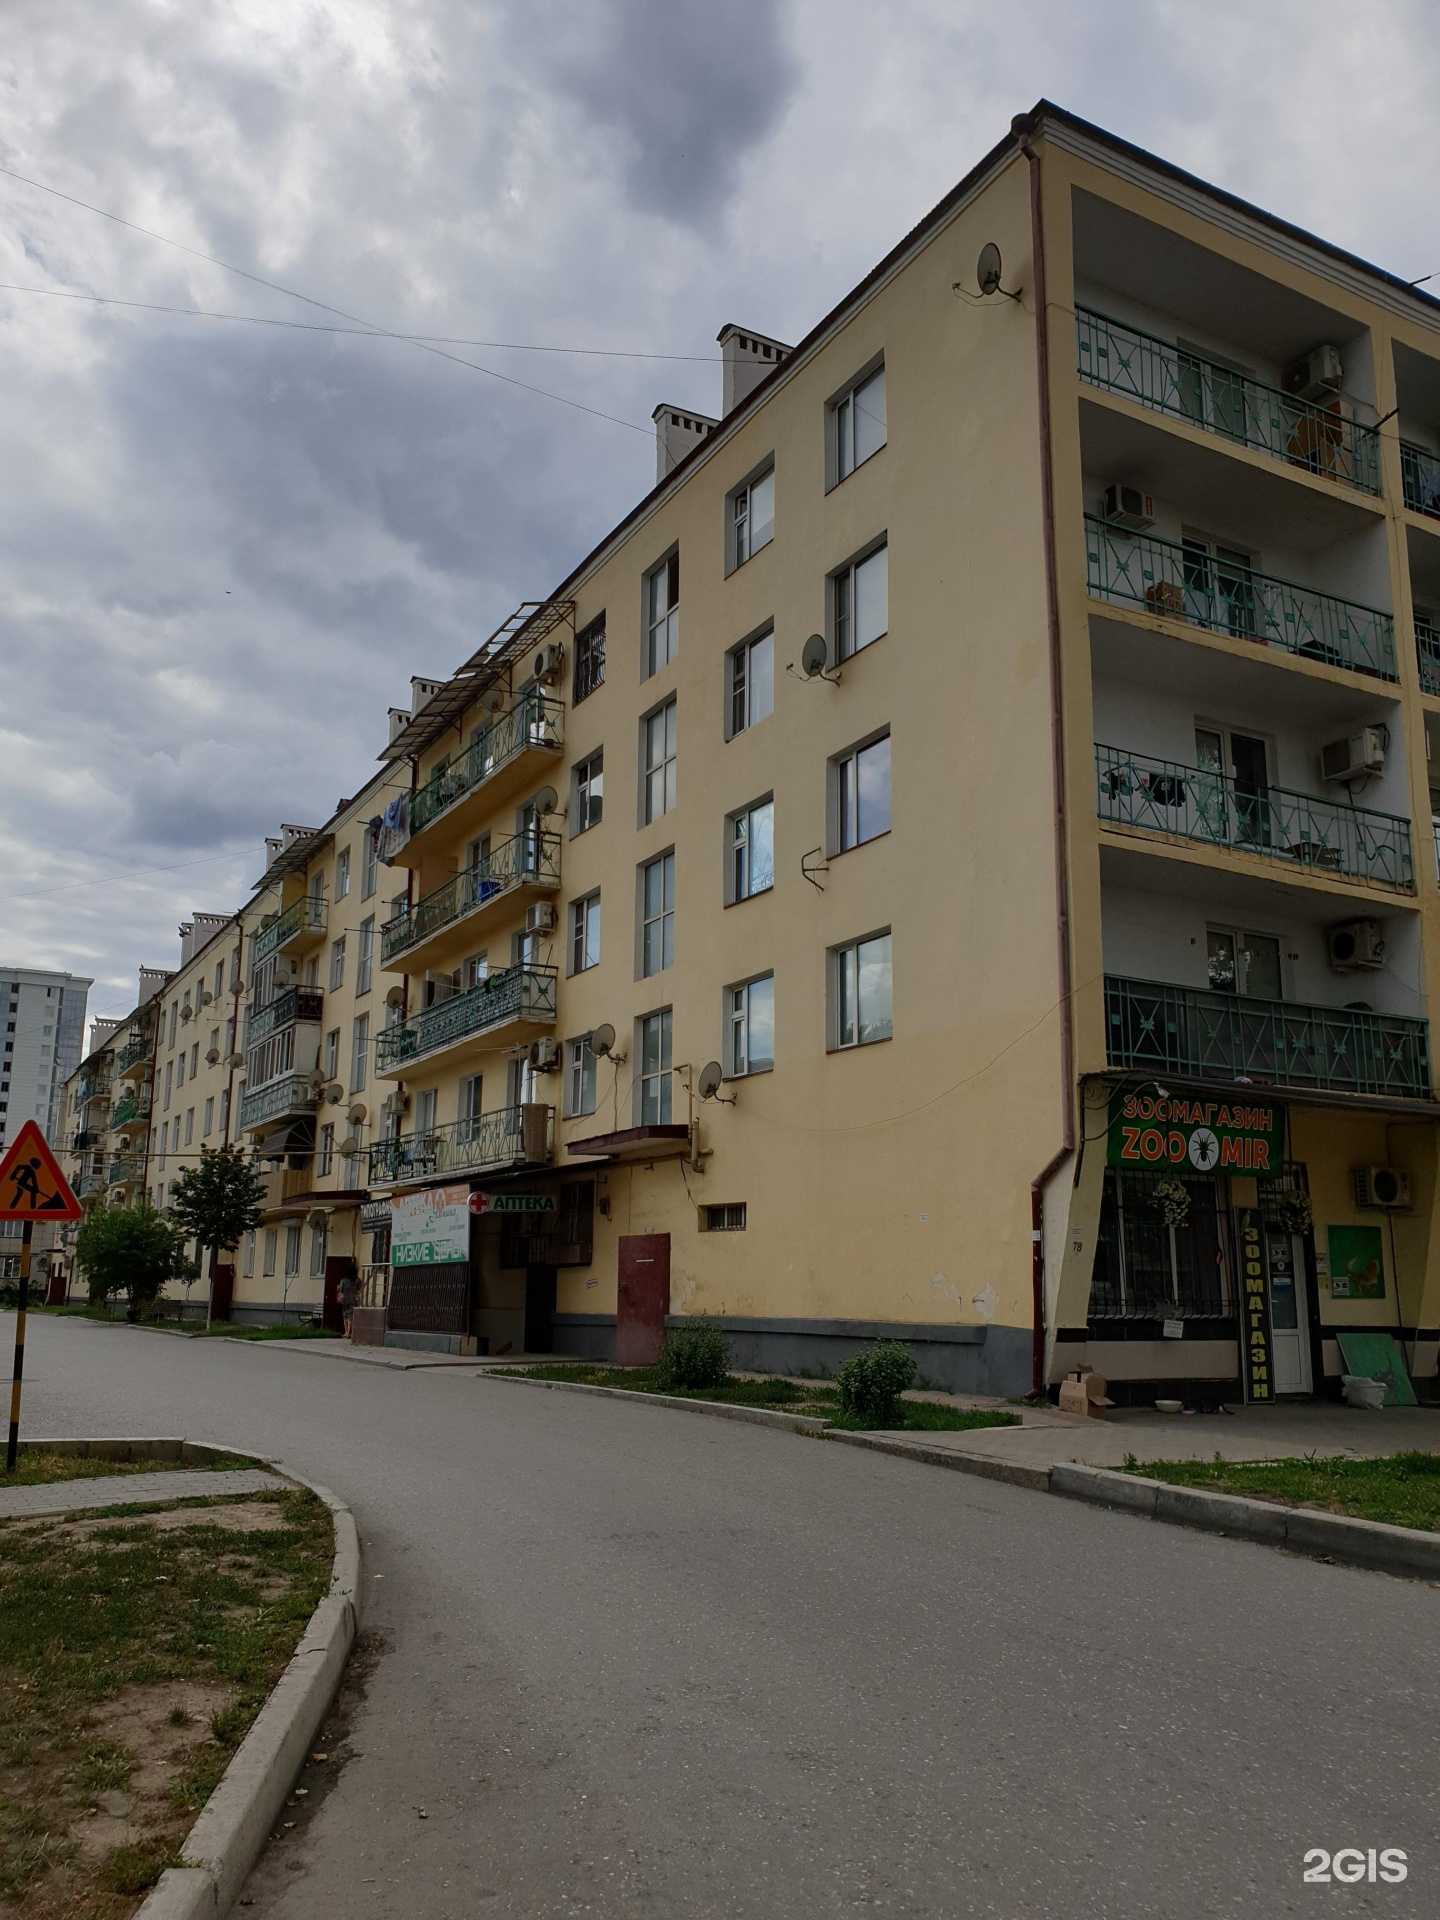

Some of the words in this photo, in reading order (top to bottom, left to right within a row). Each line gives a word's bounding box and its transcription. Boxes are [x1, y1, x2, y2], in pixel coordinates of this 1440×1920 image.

[1122, 1094, 1273, 1131] ЗООМАГАЗИН
[1120, 1126, 1187, 1163] ZOO
[1219, 1136, 1271, 1170] MIR
[494, 1196, 554, 1210] АПТЕКА
[396, 1242, 430, 1263] НИЗКИЕ
[1243, 1227, 1269, 1398] ЗООМАГАЗИН
